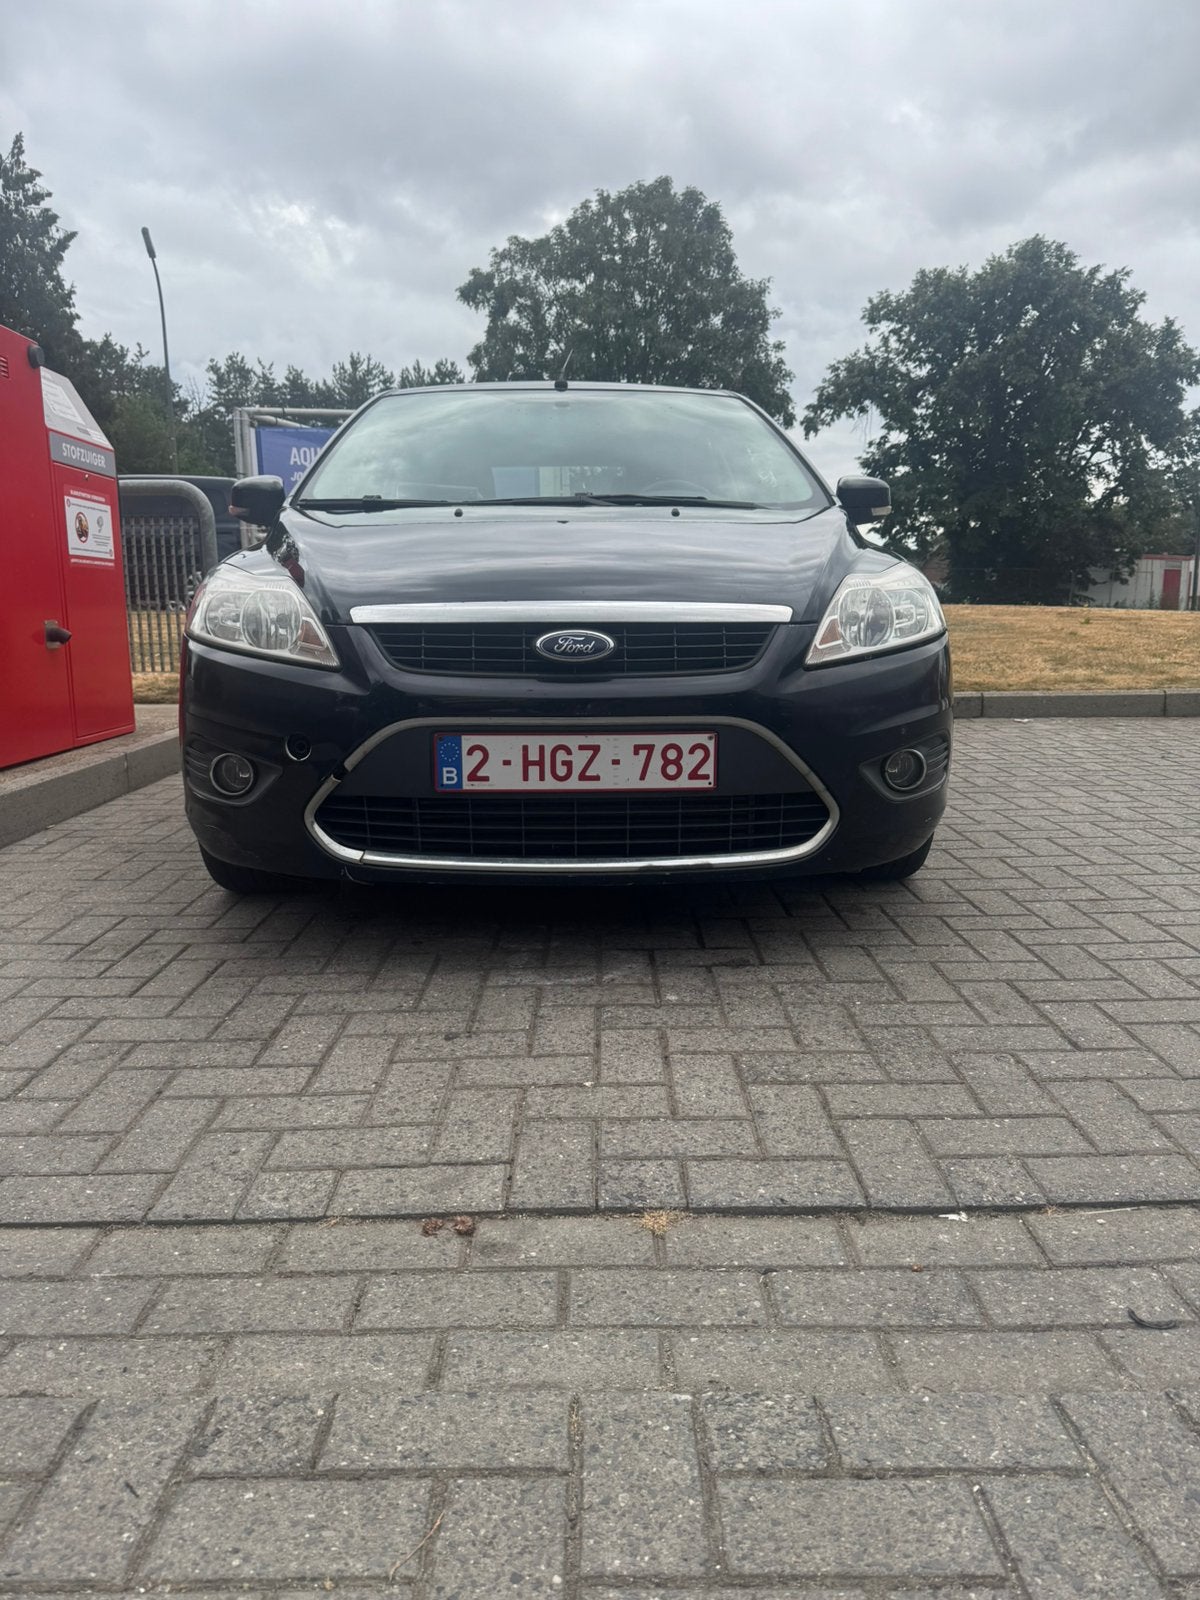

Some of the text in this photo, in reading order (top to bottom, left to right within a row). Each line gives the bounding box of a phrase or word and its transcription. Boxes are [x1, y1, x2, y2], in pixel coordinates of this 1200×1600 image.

[62, 442, 106, 468] STOFZUIGER
[554, 635, 596, 653] Ford
[442, 767, 458, 785] B
